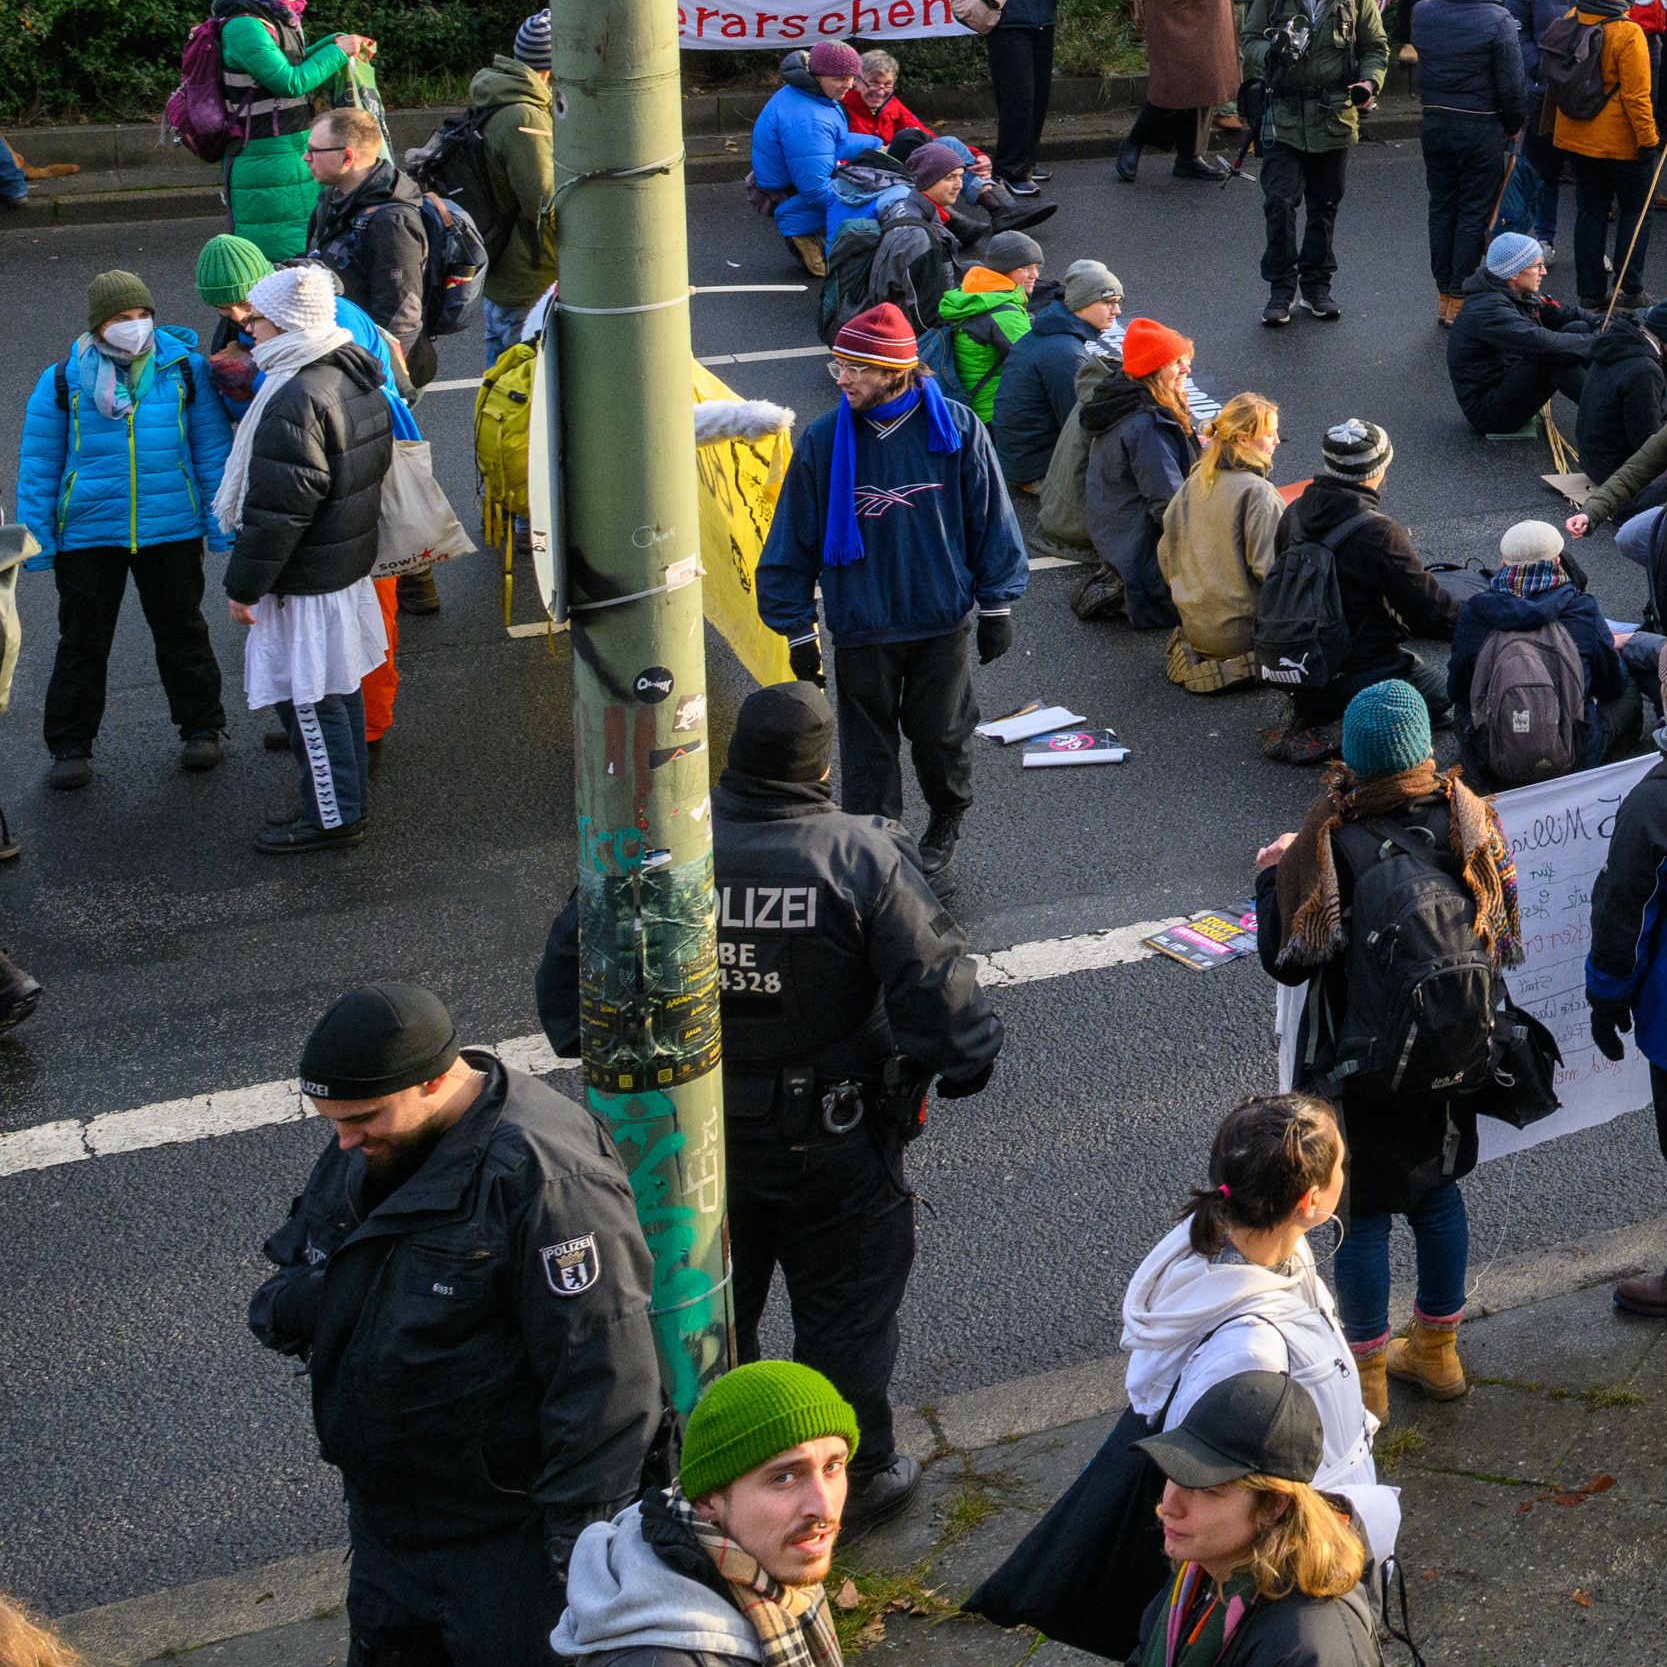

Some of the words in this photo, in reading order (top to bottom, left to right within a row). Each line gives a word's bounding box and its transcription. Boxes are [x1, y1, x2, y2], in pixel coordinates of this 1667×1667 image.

[1261, 665, 1302, 684] PUMA
[716, 887, 818, 928] LIZEI
[719, 942, 756, 967] BE
[545, 1239, 592, 1260] POLIZEI
